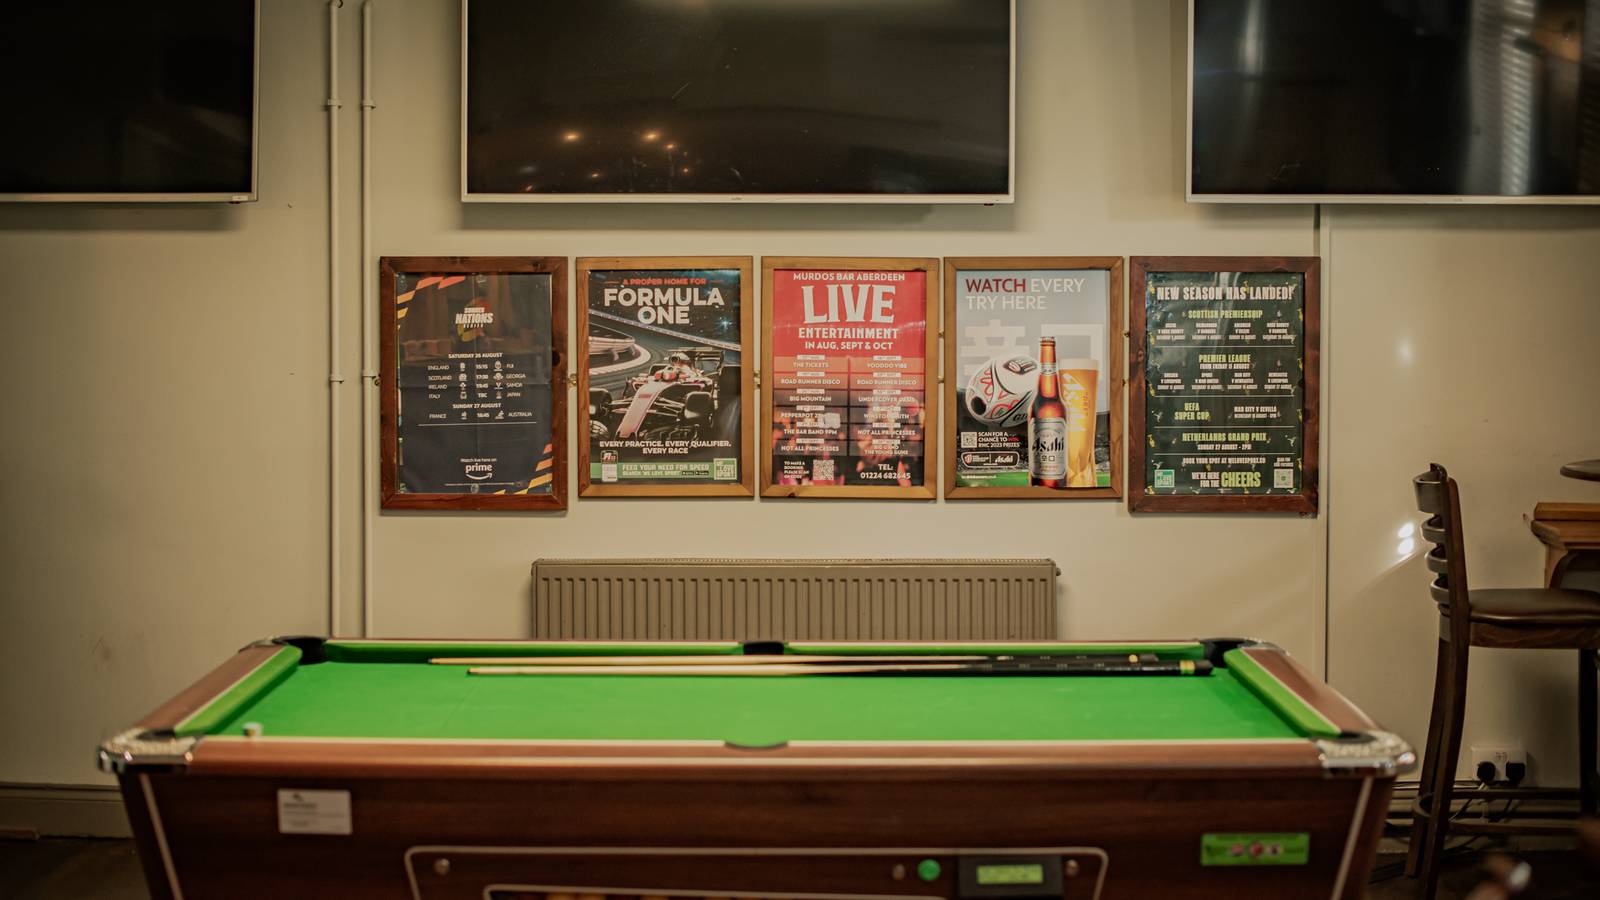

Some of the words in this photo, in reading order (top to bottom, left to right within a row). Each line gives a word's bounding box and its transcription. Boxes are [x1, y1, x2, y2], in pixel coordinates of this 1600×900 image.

[793, 273, 834, 281] MURDOS
[836, 273, 855, 281] BAR
[856, 273, 905, 281] ABERDEEN
[965, 278, 1027, 293] WATCH
[1030, 278, 1085, 293] EVERY
[604, 287, 725, 307] FORMULA
[1157, 287, 1180, 300] NEW
[1183, 287, 1223, 300] SEASON
[1226, 287, 1247, 300] HAS
[1249, 287, 1293, 300] LANDED!
[801, 284, 896, 324] LIVE
[966, 295, 998, 310] TRY
[1002, 295, 1047, 310] HERE
[455, 313, 493, 324] NATIONS
[637, 306, 690, 324] ONE
[1188, 310, 1219, 319] SCOTTISH
[1220, 310, 1263, 319] PREMIERSHIP
[798, 327, 899, 339] ENTERTAINMENT
[805, 341, 815, 350] IN
[841, 341, 863, 350] SEPT
[864, 341, 871, 350] &
[873, 341, 893, 350] OCT
[1199, 354, 1227, 363] PREMIER
[1228, 354, 1251, 363] LEAGUE
[1184, 402, 1200, 411] UEFA
[1174, 411, 1195, 420] SUPER
[1196, 411, 1210, 420] CUP
[1182, 433, 1227, 442] NETHERLANDS
[1227, 433, 1250, 442] GRAND
[1251, 433, 1267, 442] PRIX
[1032, 437, 1064, 452] Asahi
[465, 462, 493, 473] prime
[1207, 471, 1220, 480] HERE
[1221, 471, 1261, 488] CHEERS
[1200, 480, 1210, 488] FOR
[1210, 480, 1220, 488] THE
